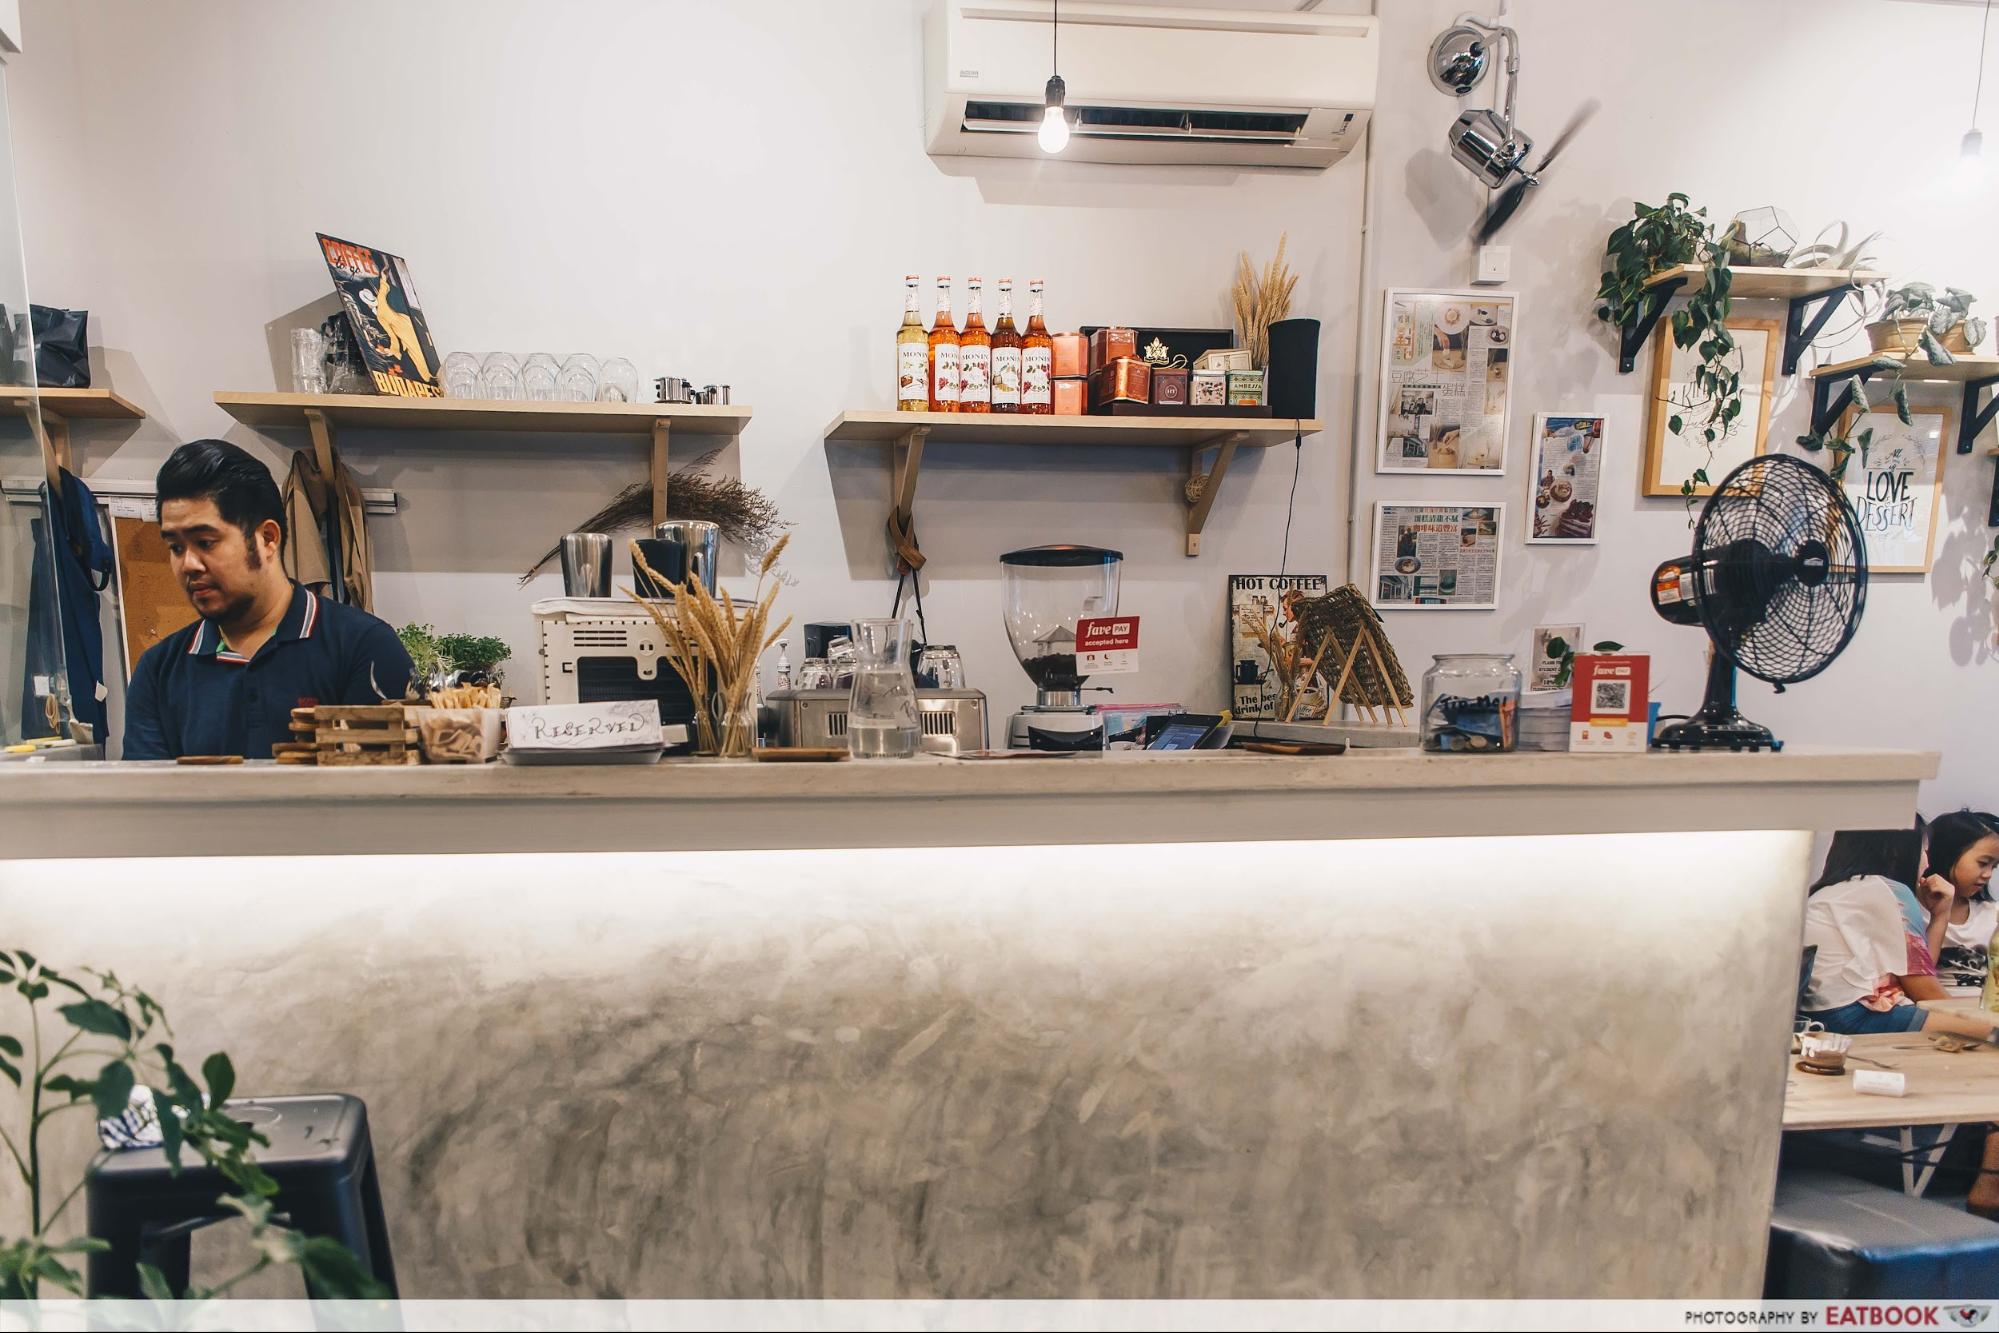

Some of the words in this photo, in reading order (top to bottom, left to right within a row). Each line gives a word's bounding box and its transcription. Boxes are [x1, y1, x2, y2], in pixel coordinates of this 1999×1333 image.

[320, 238, 380, 276] COFFEE
[372, 370, 444, 397] BUDAPES
[1867, 471, 1914, 503] LOVE
[1856, 496, 1918, 532] DESSERT
[1236, 578, 1264, 590] HOT
[1085, 621, 1112, 638] fave
[1113, 624, 1129, 633] PAY
[1085, 638, 1114, 647] accepted
[1236, 704, 1261, 715] drink
[1264, 702, 1274, 711] of
[1240, 695, 1258, 705] The
[531, 713, 645, 739] RESERVED
